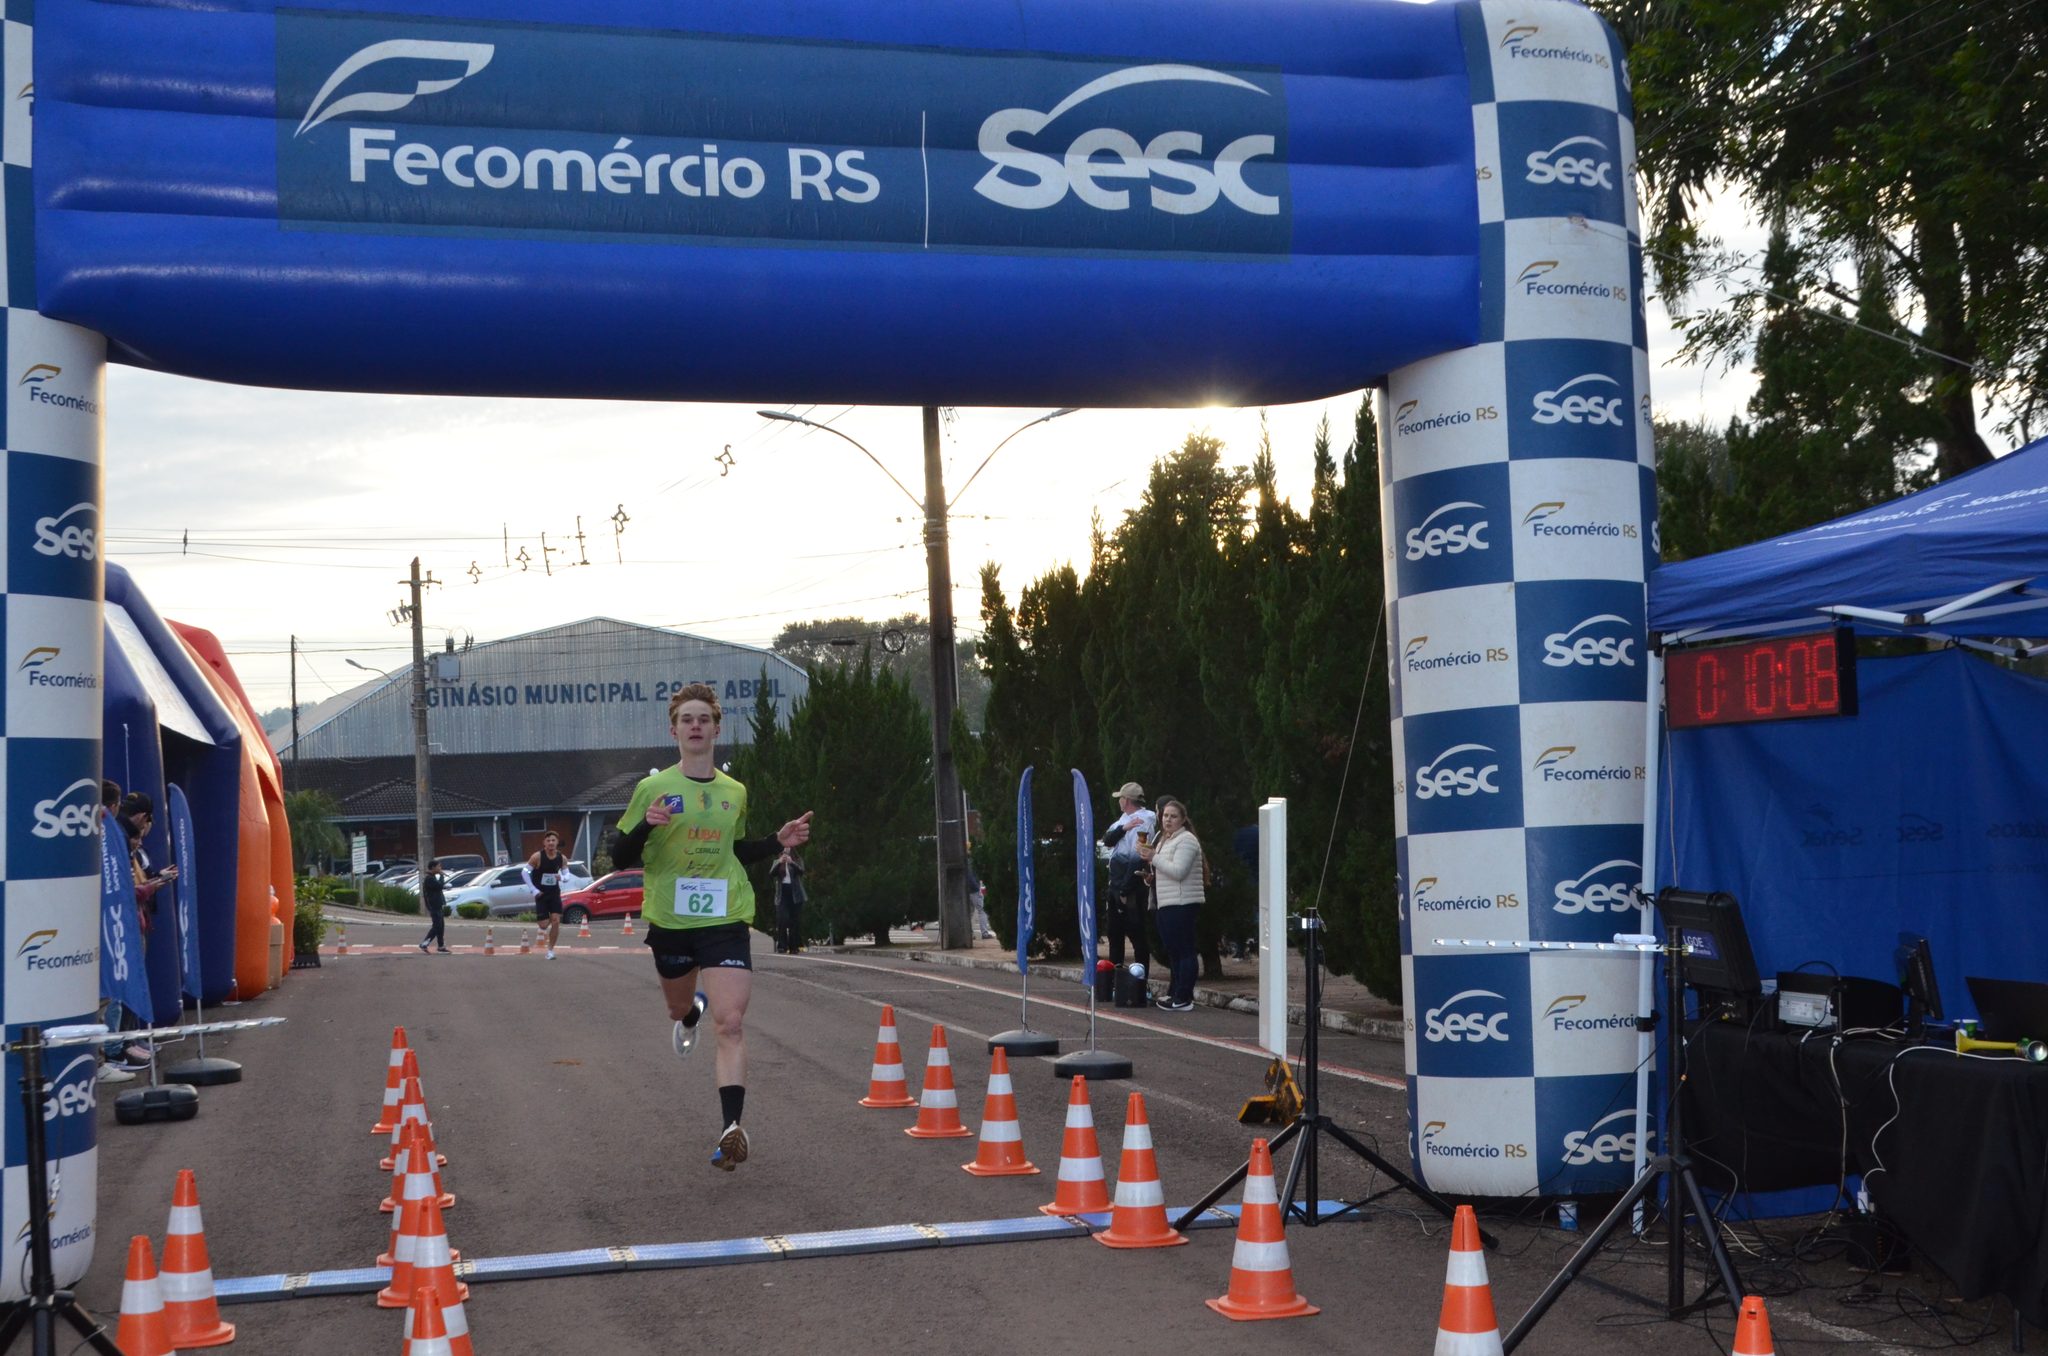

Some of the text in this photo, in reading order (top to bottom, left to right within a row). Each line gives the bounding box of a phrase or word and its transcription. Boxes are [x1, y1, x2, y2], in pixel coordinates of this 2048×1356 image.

[1510, 46, 1593, 64] Fecomércio
[973, 64, 1280, 215] Sesc
[349, 128, 881, 204] Fecomércio RS
[1525, 136, 1613, 190] Sesc
[1526, 281, 1627, 301] Fecomércio RS
[1531, 373, 1624, 426] Sesc
[1398, 406, 1498, 437] Fecomércio RS
[1405, 501, 1490, 561] Sesc
[1533, 521, 1620, 537] Fecomércio
[1622, 524, 1638, 539] RS
[1542, 614, 1635, 667] Sesc
[1408, 648, 1510, 672] Fecomércio RS
[426, 682, 518, 707] GINÁSIO
[525, 682, 648, 705] MUNICIPAL
[1415, 743, 1500, 800] Sesc
[1543, 765, 1632, 782] Fecomércio
[688, 893, 713, 913] 62
[1417, 896, 1491, 912] Fecomércio
[1495, 894, 1519, 909] RS
[103, 904, 129, 981] Sesc
[1425, 989, 1509, 1042] Sesc
[1426, 1141, 1499, 1158] Fecomércio
[1504, 1144, 1528, 1158] RS
